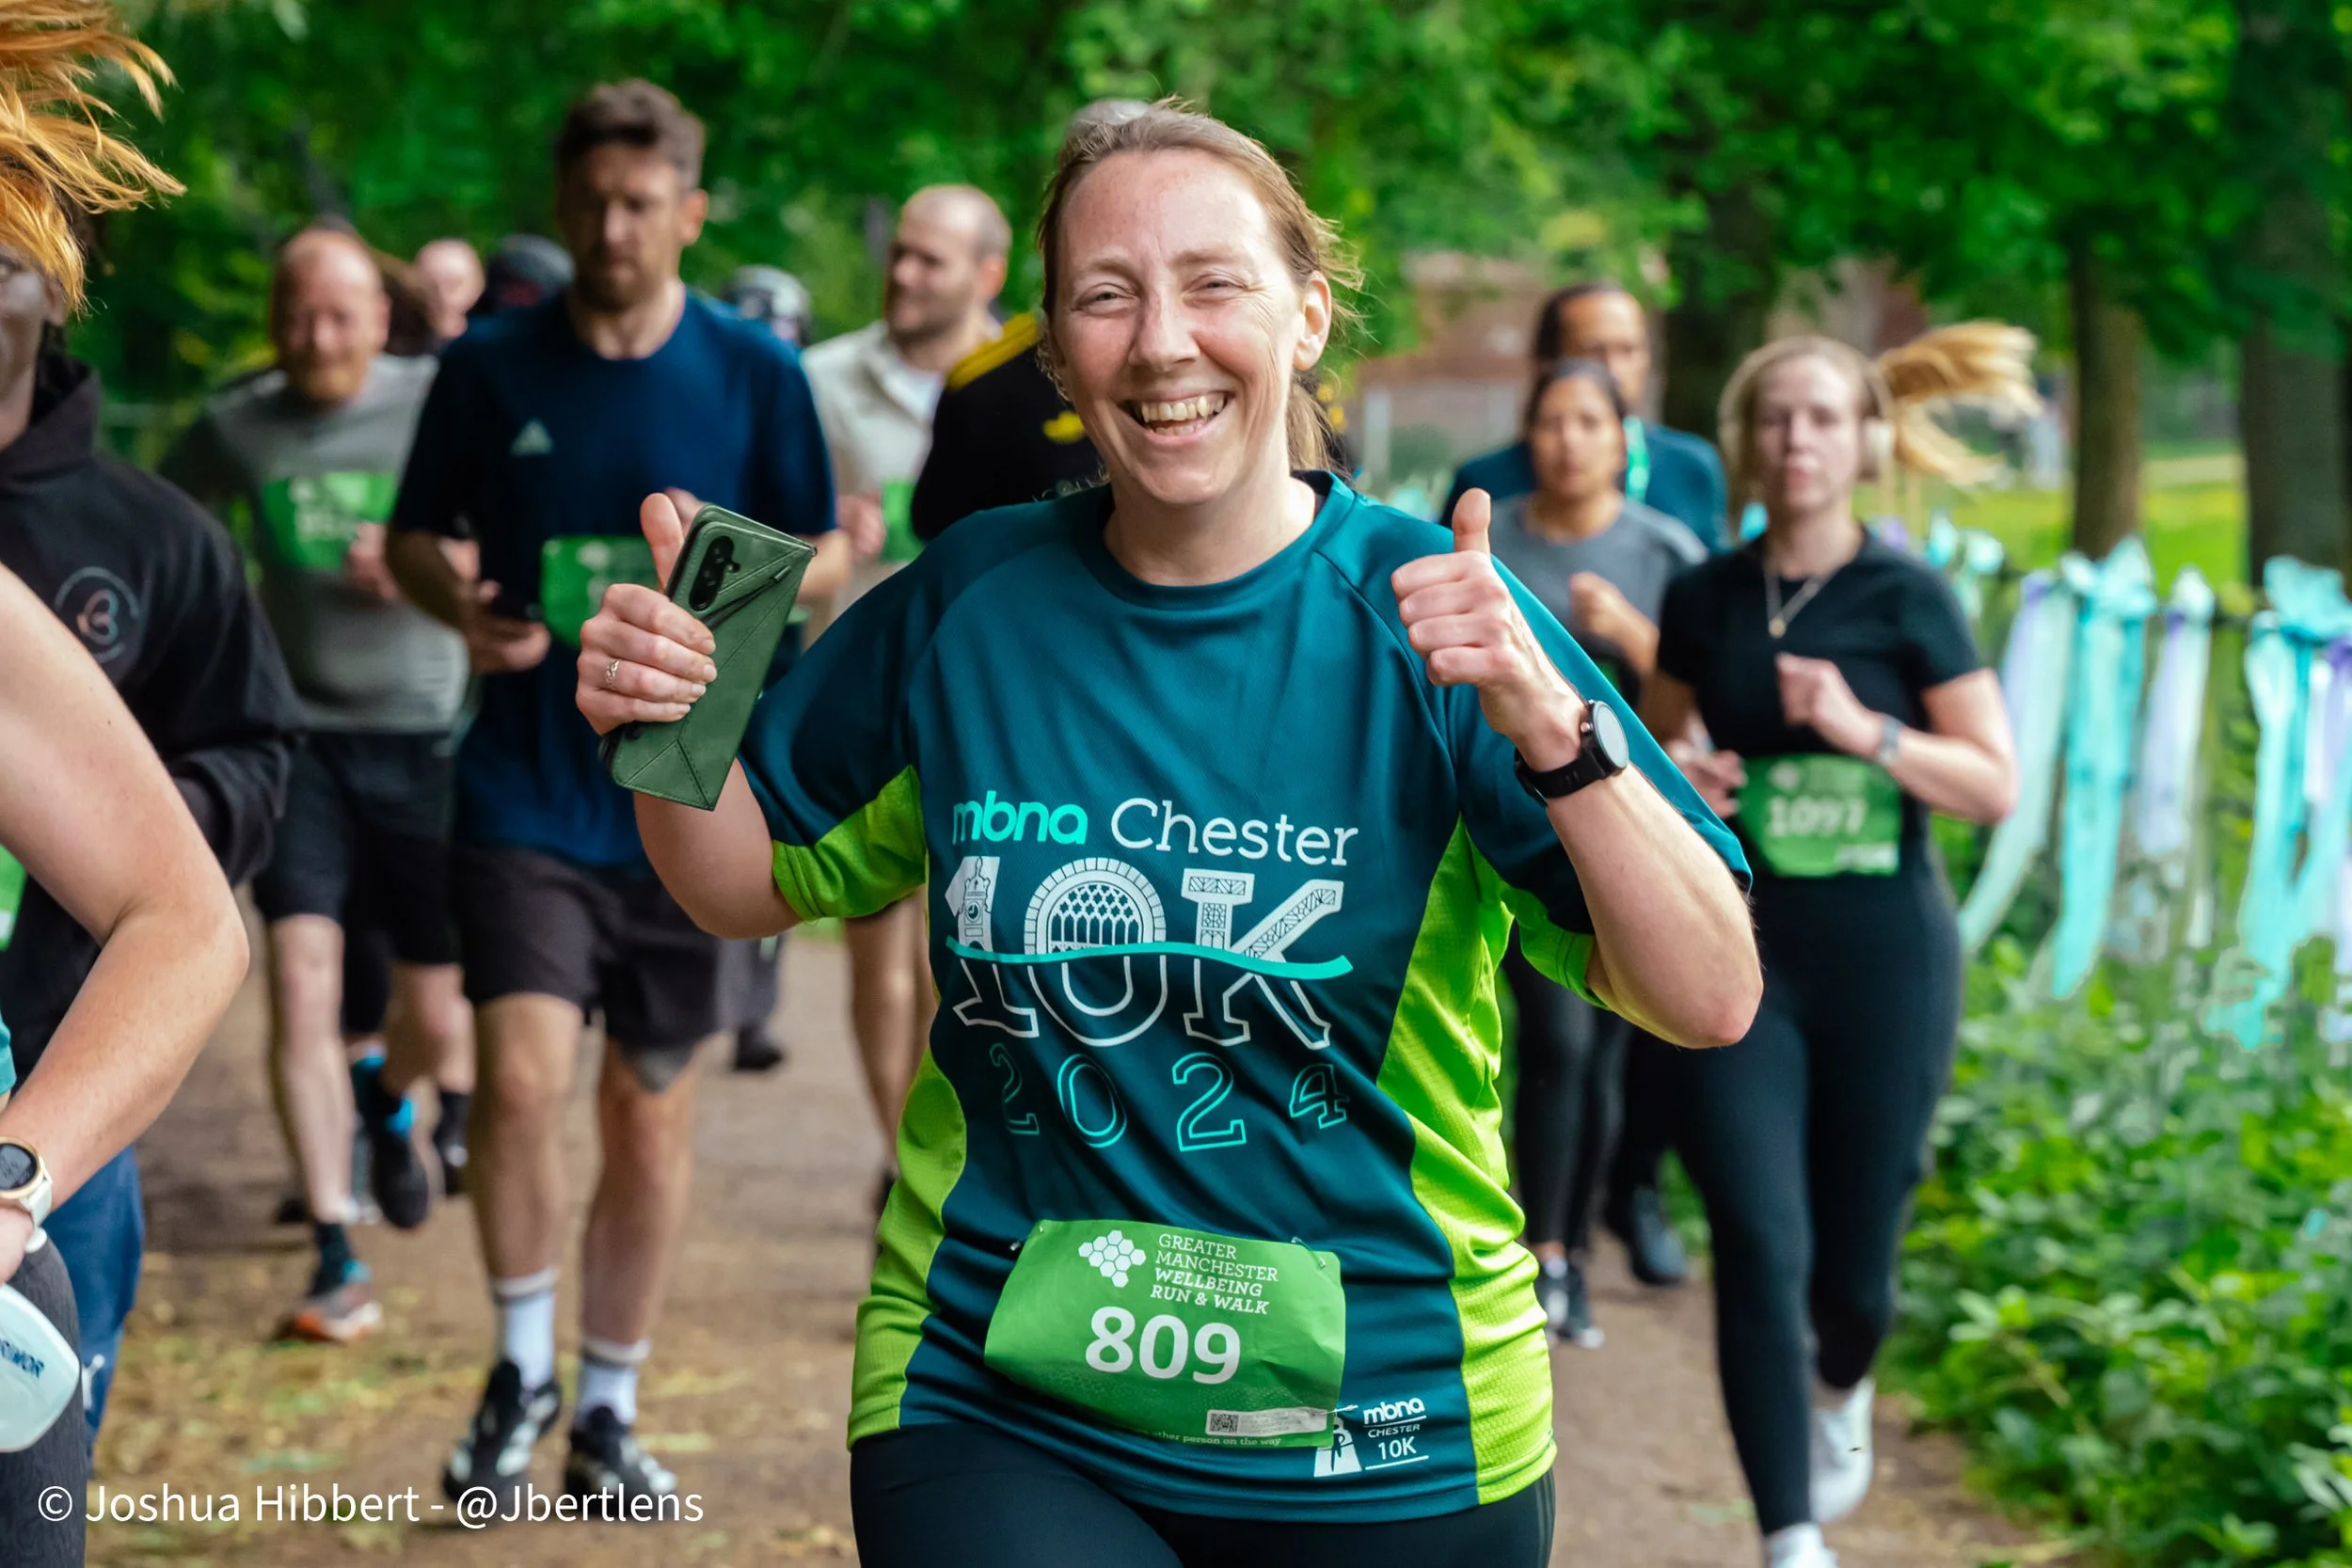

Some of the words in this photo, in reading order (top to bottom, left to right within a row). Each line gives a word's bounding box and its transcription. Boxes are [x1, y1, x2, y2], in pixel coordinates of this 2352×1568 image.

[952, 790, 1089, 847] mbna
[1110, 797, 1359, 867] Chester
[945, 855, 1345, 1051] 10K
[989, 1042, 1350, 1153] 2024
[1158, 1233, 1237, 1259] GREATER
[1155, 1250, 1279, 1282] MANCHESTER
[1154, 1267, 1263, 1297] WELLBEING
[1150, 1284, 1192, 1304] RUN
[1194, 1291, 1208, 1307] &
[1213, 1293, 1270, 1315] WALK
[1085, 1306, 1242, 1386] 809
[1362, 1397, 1425, 1425] mbna
[1183, 1435, 1220, 1446] person
[1222, 1437, 1237, 1446] on
[1239, 1436, 1258, 1446] the
[1260, 1436, 1282, 1447] way
[1367, 1423, 1421, 1438] CHESTER
[1378, 1435, 1417, 1461] 10K
